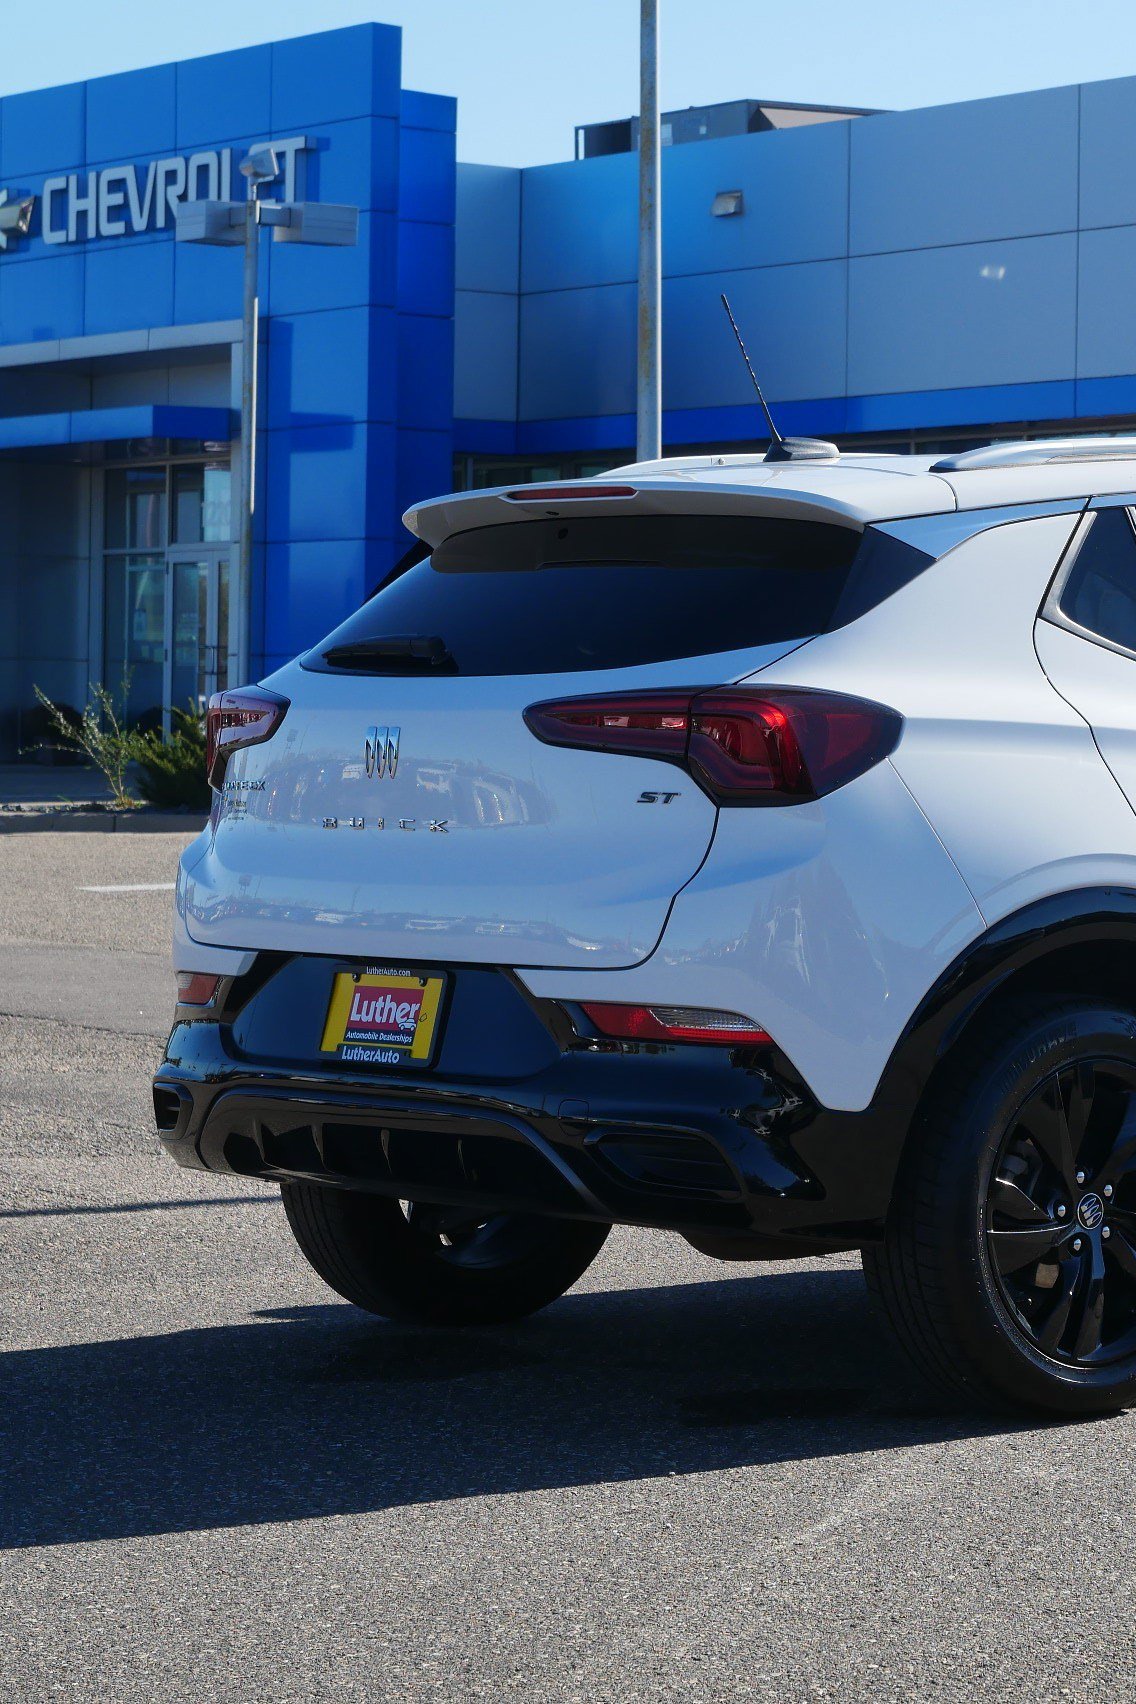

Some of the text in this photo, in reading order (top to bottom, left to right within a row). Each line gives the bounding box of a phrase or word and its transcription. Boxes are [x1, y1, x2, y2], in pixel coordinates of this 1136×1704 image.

[636, 791, 681, 804] ST
[322, 816, 449, 833] BUICK
[366, 966, 411, 977] LutherAuto.com
[350, 992, 420, 1024] Luther
[346, 1030, 412, 1044] Automobile Dealerships
[341, 1045, 400, 1064] LutherAuto
